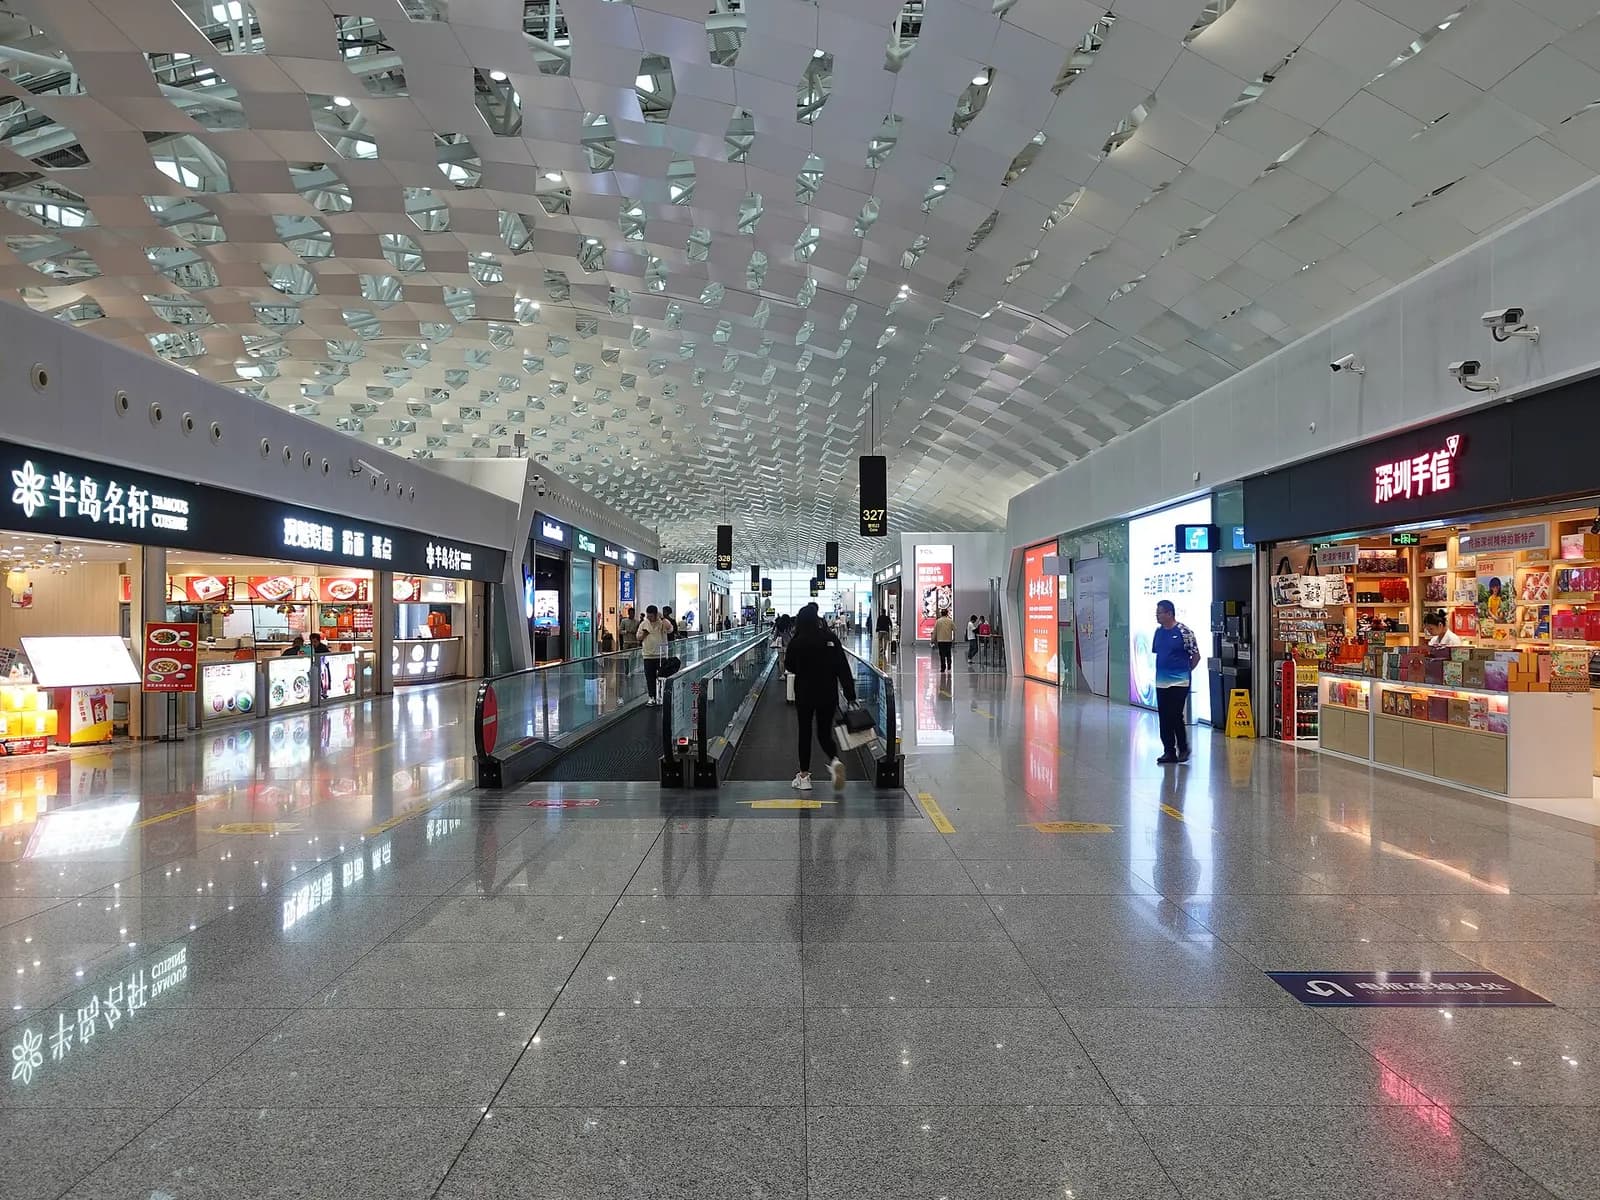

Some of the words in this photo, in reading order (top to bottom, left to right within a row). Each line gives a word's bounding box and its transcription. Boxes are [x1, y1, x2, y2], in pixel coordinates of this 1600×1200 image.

[1375, 450, 1450, 503] 深圳手信
[49, 471, 149, 528] 半岛名轩
[152, 495, 189, 514] FAMOUS
[152, 513, 188, 531] CUISINE
[863, 510, 884, 520] 327
[435, 544, 461, 571] 半岛名轩
